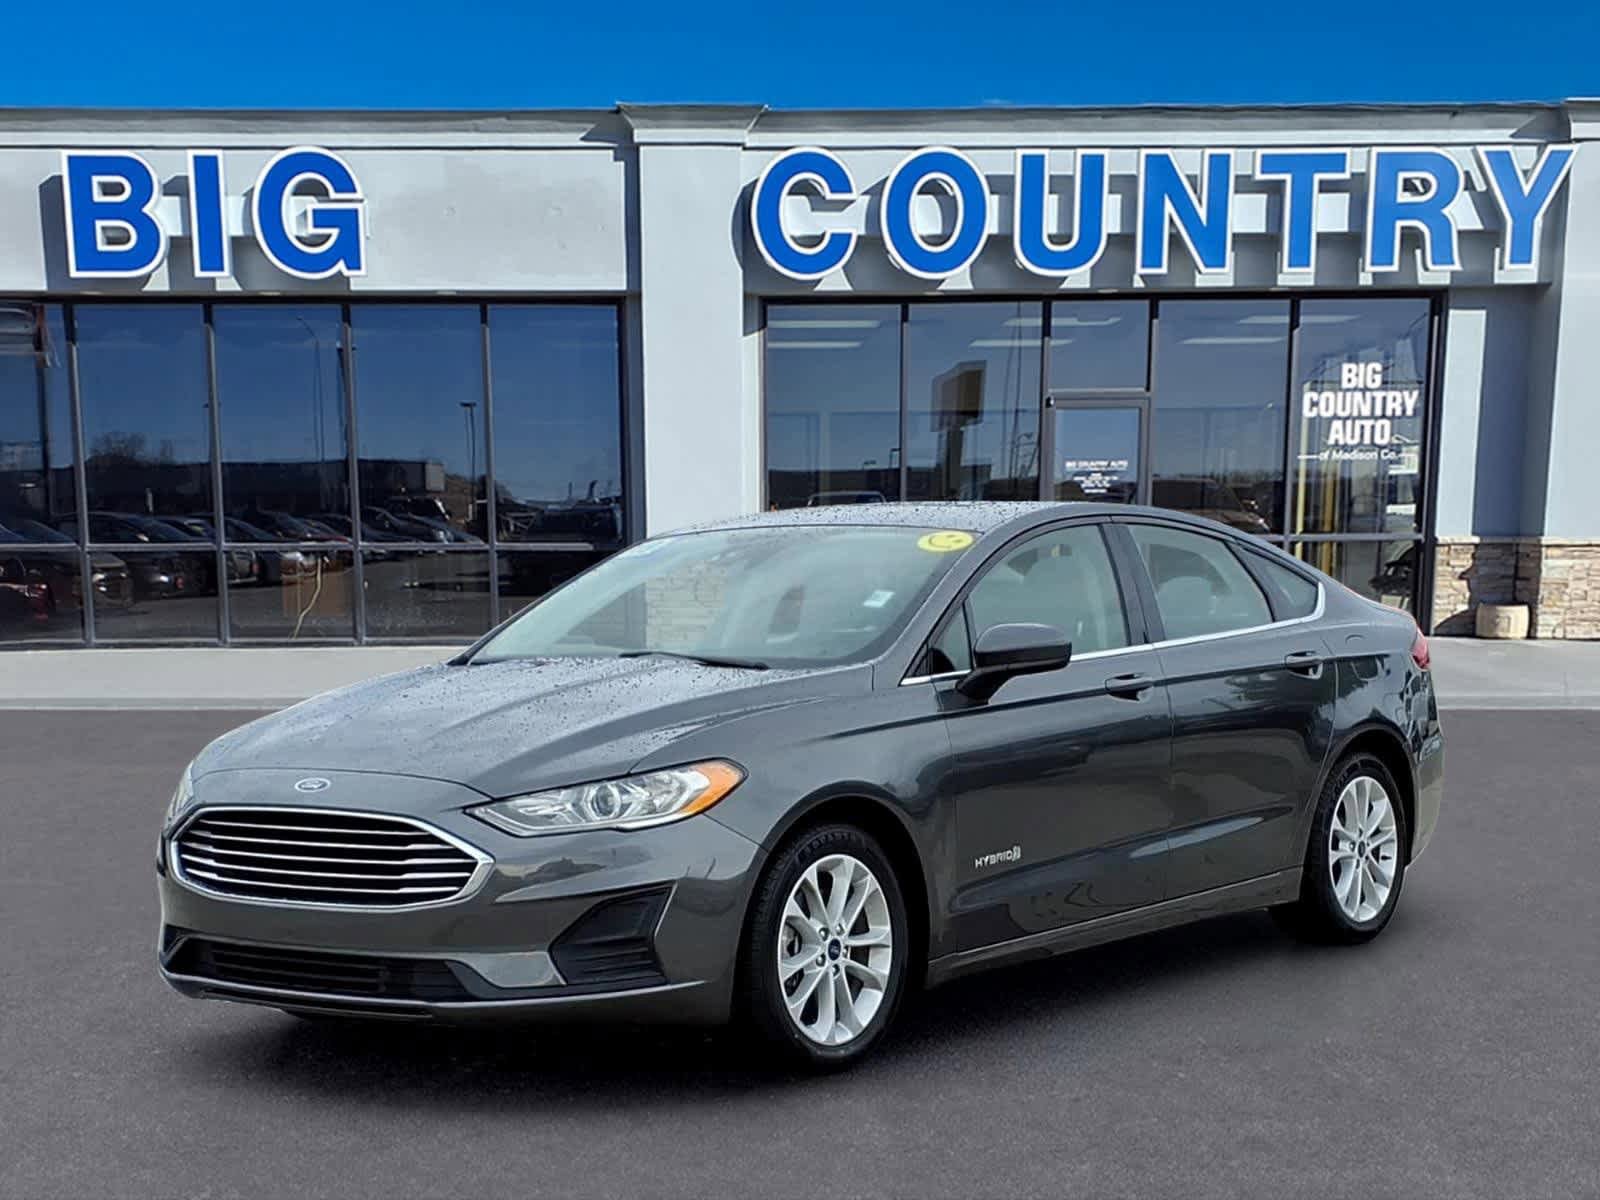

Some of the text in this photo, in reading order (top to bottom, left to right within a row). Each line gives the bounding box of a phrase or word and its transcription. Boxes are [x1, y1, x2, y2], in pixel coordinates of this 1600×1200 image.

[62, 145, 1577, 280] BIG COUNTRY
[1341, 362, 1382, 389] BIG
[1302, 390, 1419, 418] COUNTRY
[1327, 418, 1391, 445] AUTO
